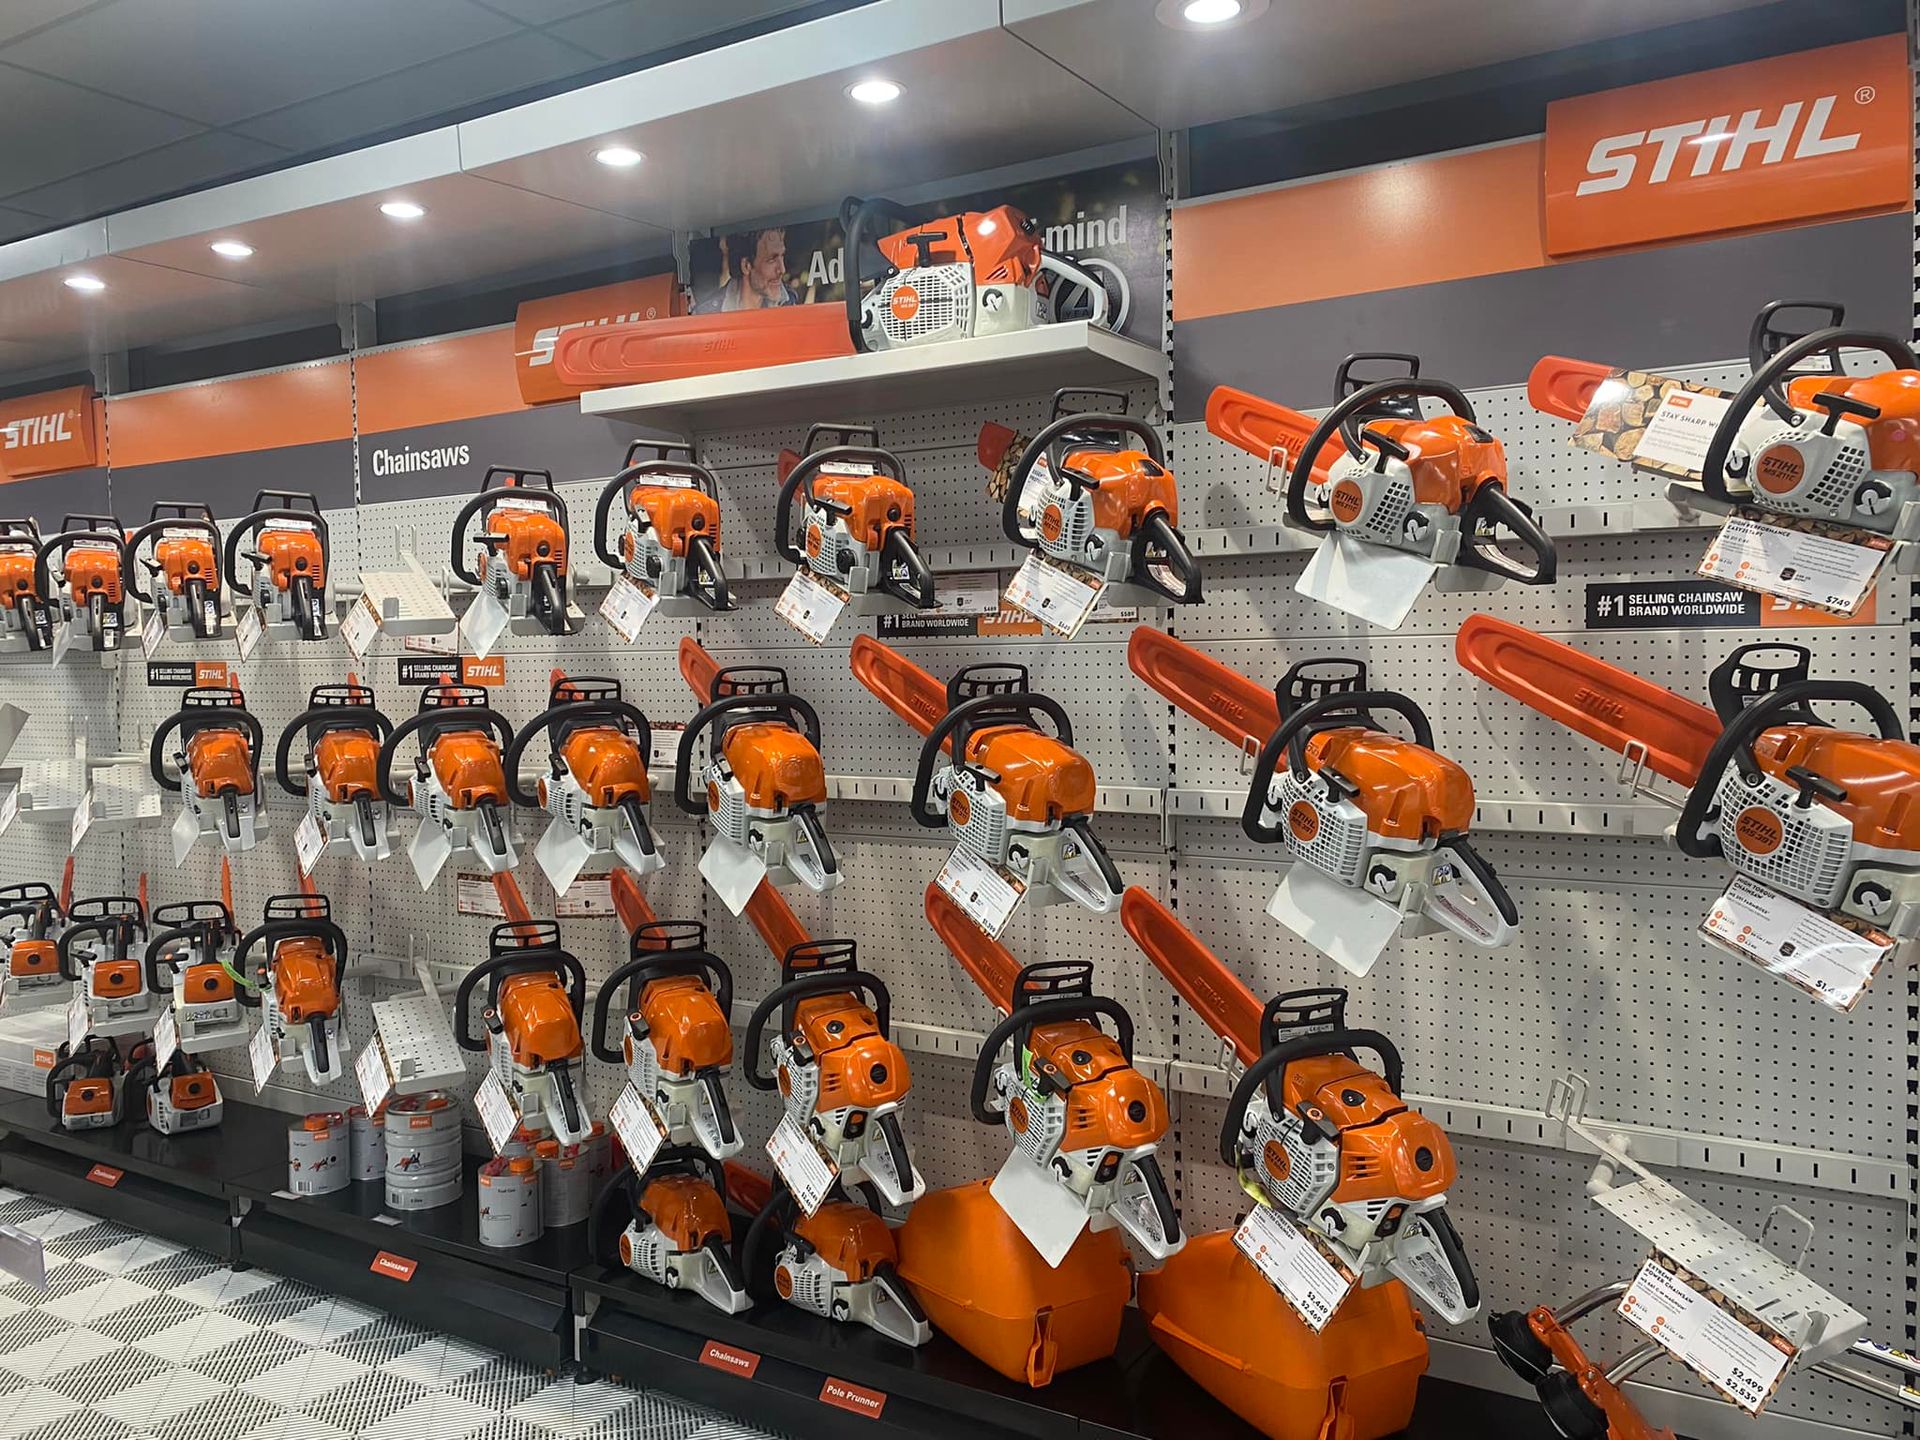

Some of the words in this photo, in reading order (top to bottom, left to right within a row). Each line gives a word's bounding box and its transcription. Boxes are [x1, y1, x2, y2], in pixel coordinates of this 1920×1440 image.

[1576, 95, 1861, 197] STIHL
[1046, 204, 1127, 253] mind
[892, 295, 918, 305] STIHL
[704, 338, 737, 353] STIHL
[1661, 411, 1678, 421] STAY
[1680, 415, 1707, 426] SHARP
[1708, 421, 1720, 429] WI
[4, 412, 72, 450] STIHL
[373, 445, 470, 476] Chainsaws
[1762, 456, 1800, 475] STIHL
[1334, 490, 1359, 506] STIHL
[1044, 512, 1061, 528] STIHL
[1597, 595, 1623, 617] #1
[1629, 593, 1674, 605] SELLING
[1678, 591, 1743, 603] CHAINSAW
[1629, 605, 1669, 617] BRAND
[1671, 603, 1745, 616] WORLDWIDE
[1825, 595, 1851, 608] $749
[883, 614, 899, 628] #1
[901, 620, 925, 628] BRAND
[926, 618, 969, 628] WORLDWIDE
[198, 669, 224, 679] STIHL
[402, 664, 413, 679] #1
[466, 665, 500, 677] STIHL
[1209, 692, 1243, 719] STIHL
[1574, 687, 1624, 719] STIHL
[1291, 808, 1315, 829] STIHL
[1741, 816, 1777, 840] STIHL
[1733, 882, 1764, 900] CHAINSAW
[1736, 876, 1752, 886] HIGH
[1752, 883, 1776, 899] TORQUE
[1266, 1145, 1288, 1172] STIHL
[380, 1258, 409, 1273] Chainsaws
[1648, 1263, 1674, 1282] EXTREME
[1645, 1268, 1665, 1285] POWER
[1664, 1281, 1694, 1304] CHAINSAW
[709, 1349, 750, 1368] Chainsaws
[1732, 1367, 1764, 1393] $2,499
[827, 1385, 845, 1397] Pole
[846, 1391, 880, 1409] Prunner
[1725, 1377, 1757, 1404] $2,539
